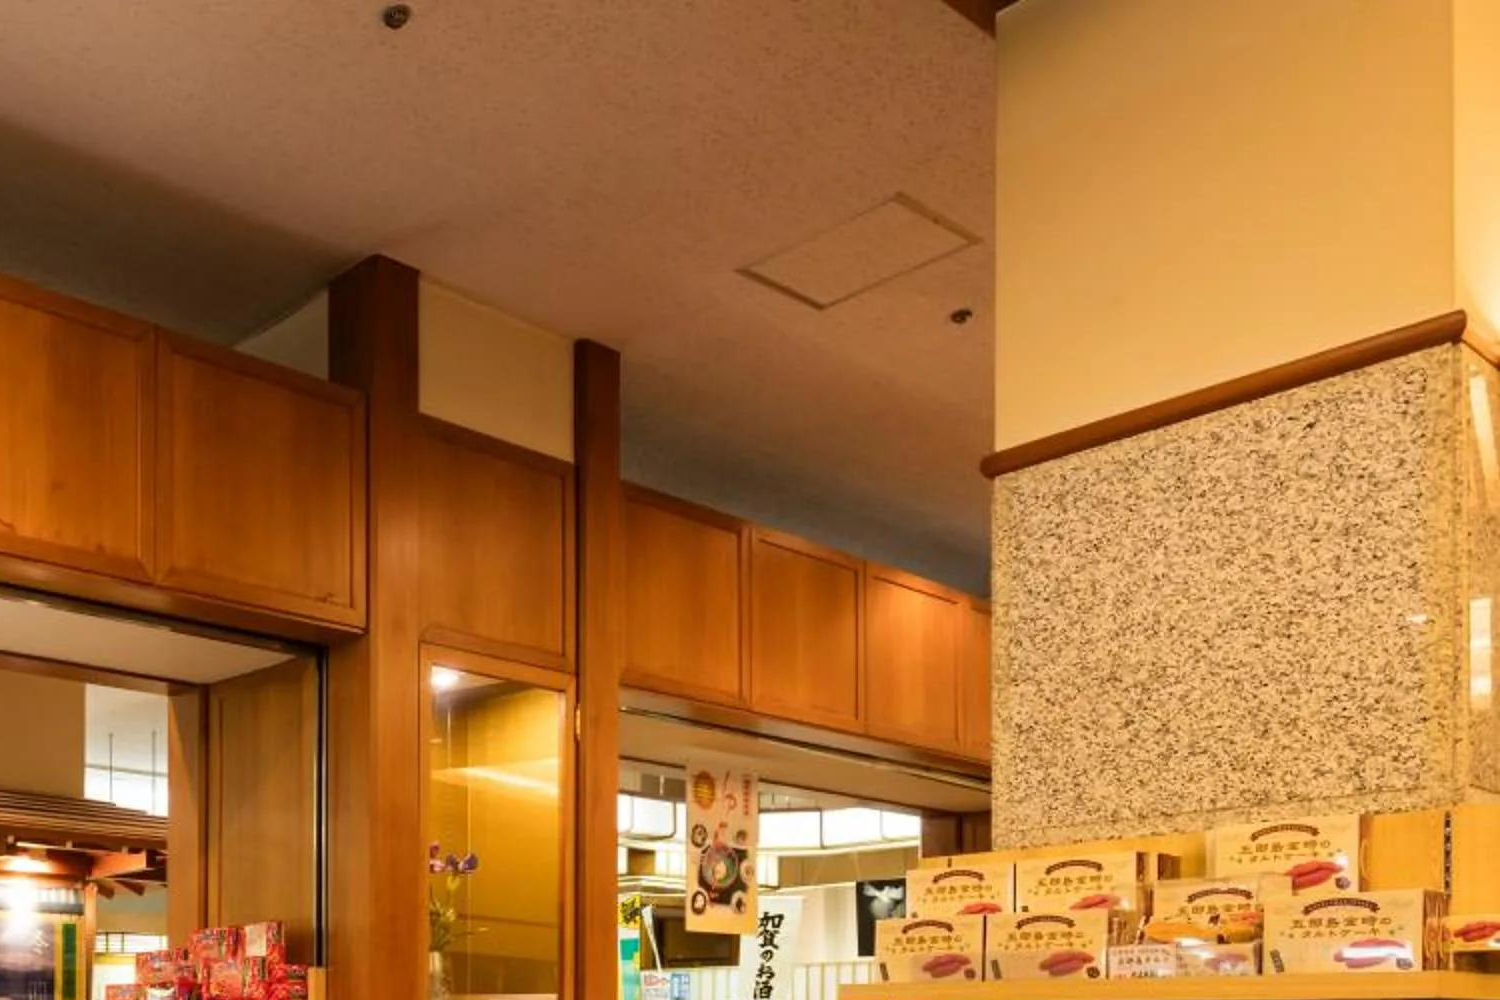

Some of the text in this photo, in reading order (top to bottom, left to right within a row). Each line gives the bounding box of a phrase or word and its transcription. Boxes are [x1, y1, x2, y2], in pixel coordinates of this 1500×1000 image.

[753, 912, 785, 1000] 加賀のお酒
